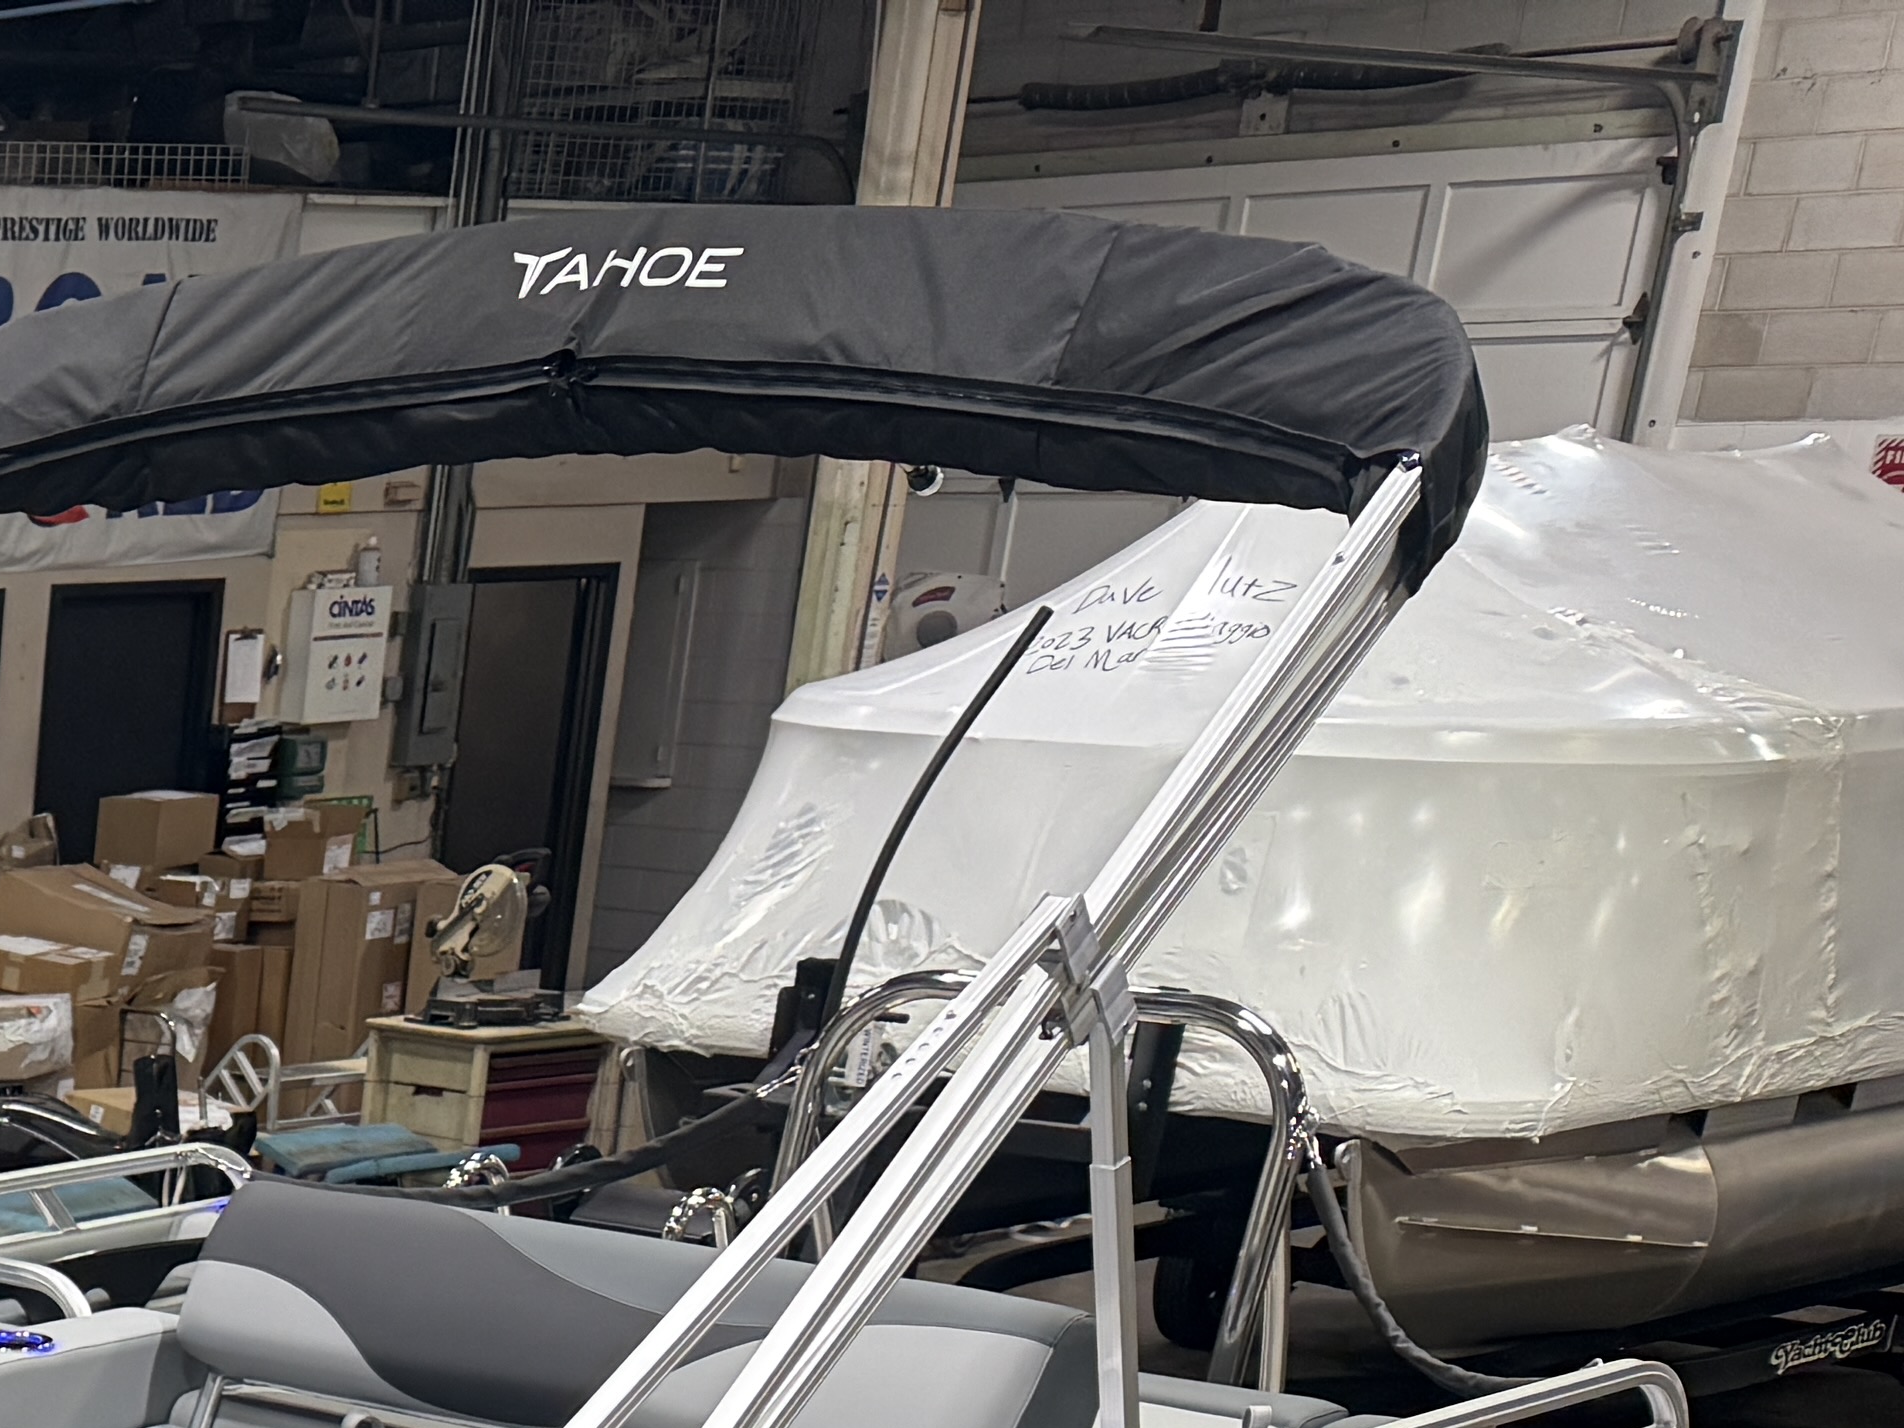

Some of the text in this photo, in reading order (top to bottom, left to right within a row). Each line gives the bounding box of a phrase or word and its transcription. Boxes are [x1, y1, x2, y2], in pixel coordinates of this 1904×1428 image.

[97, 217, 219, 243] WORLDWIDE
[513, 246, 745, 300] TAHOE
[1885, 450, 1904, 464] FI
